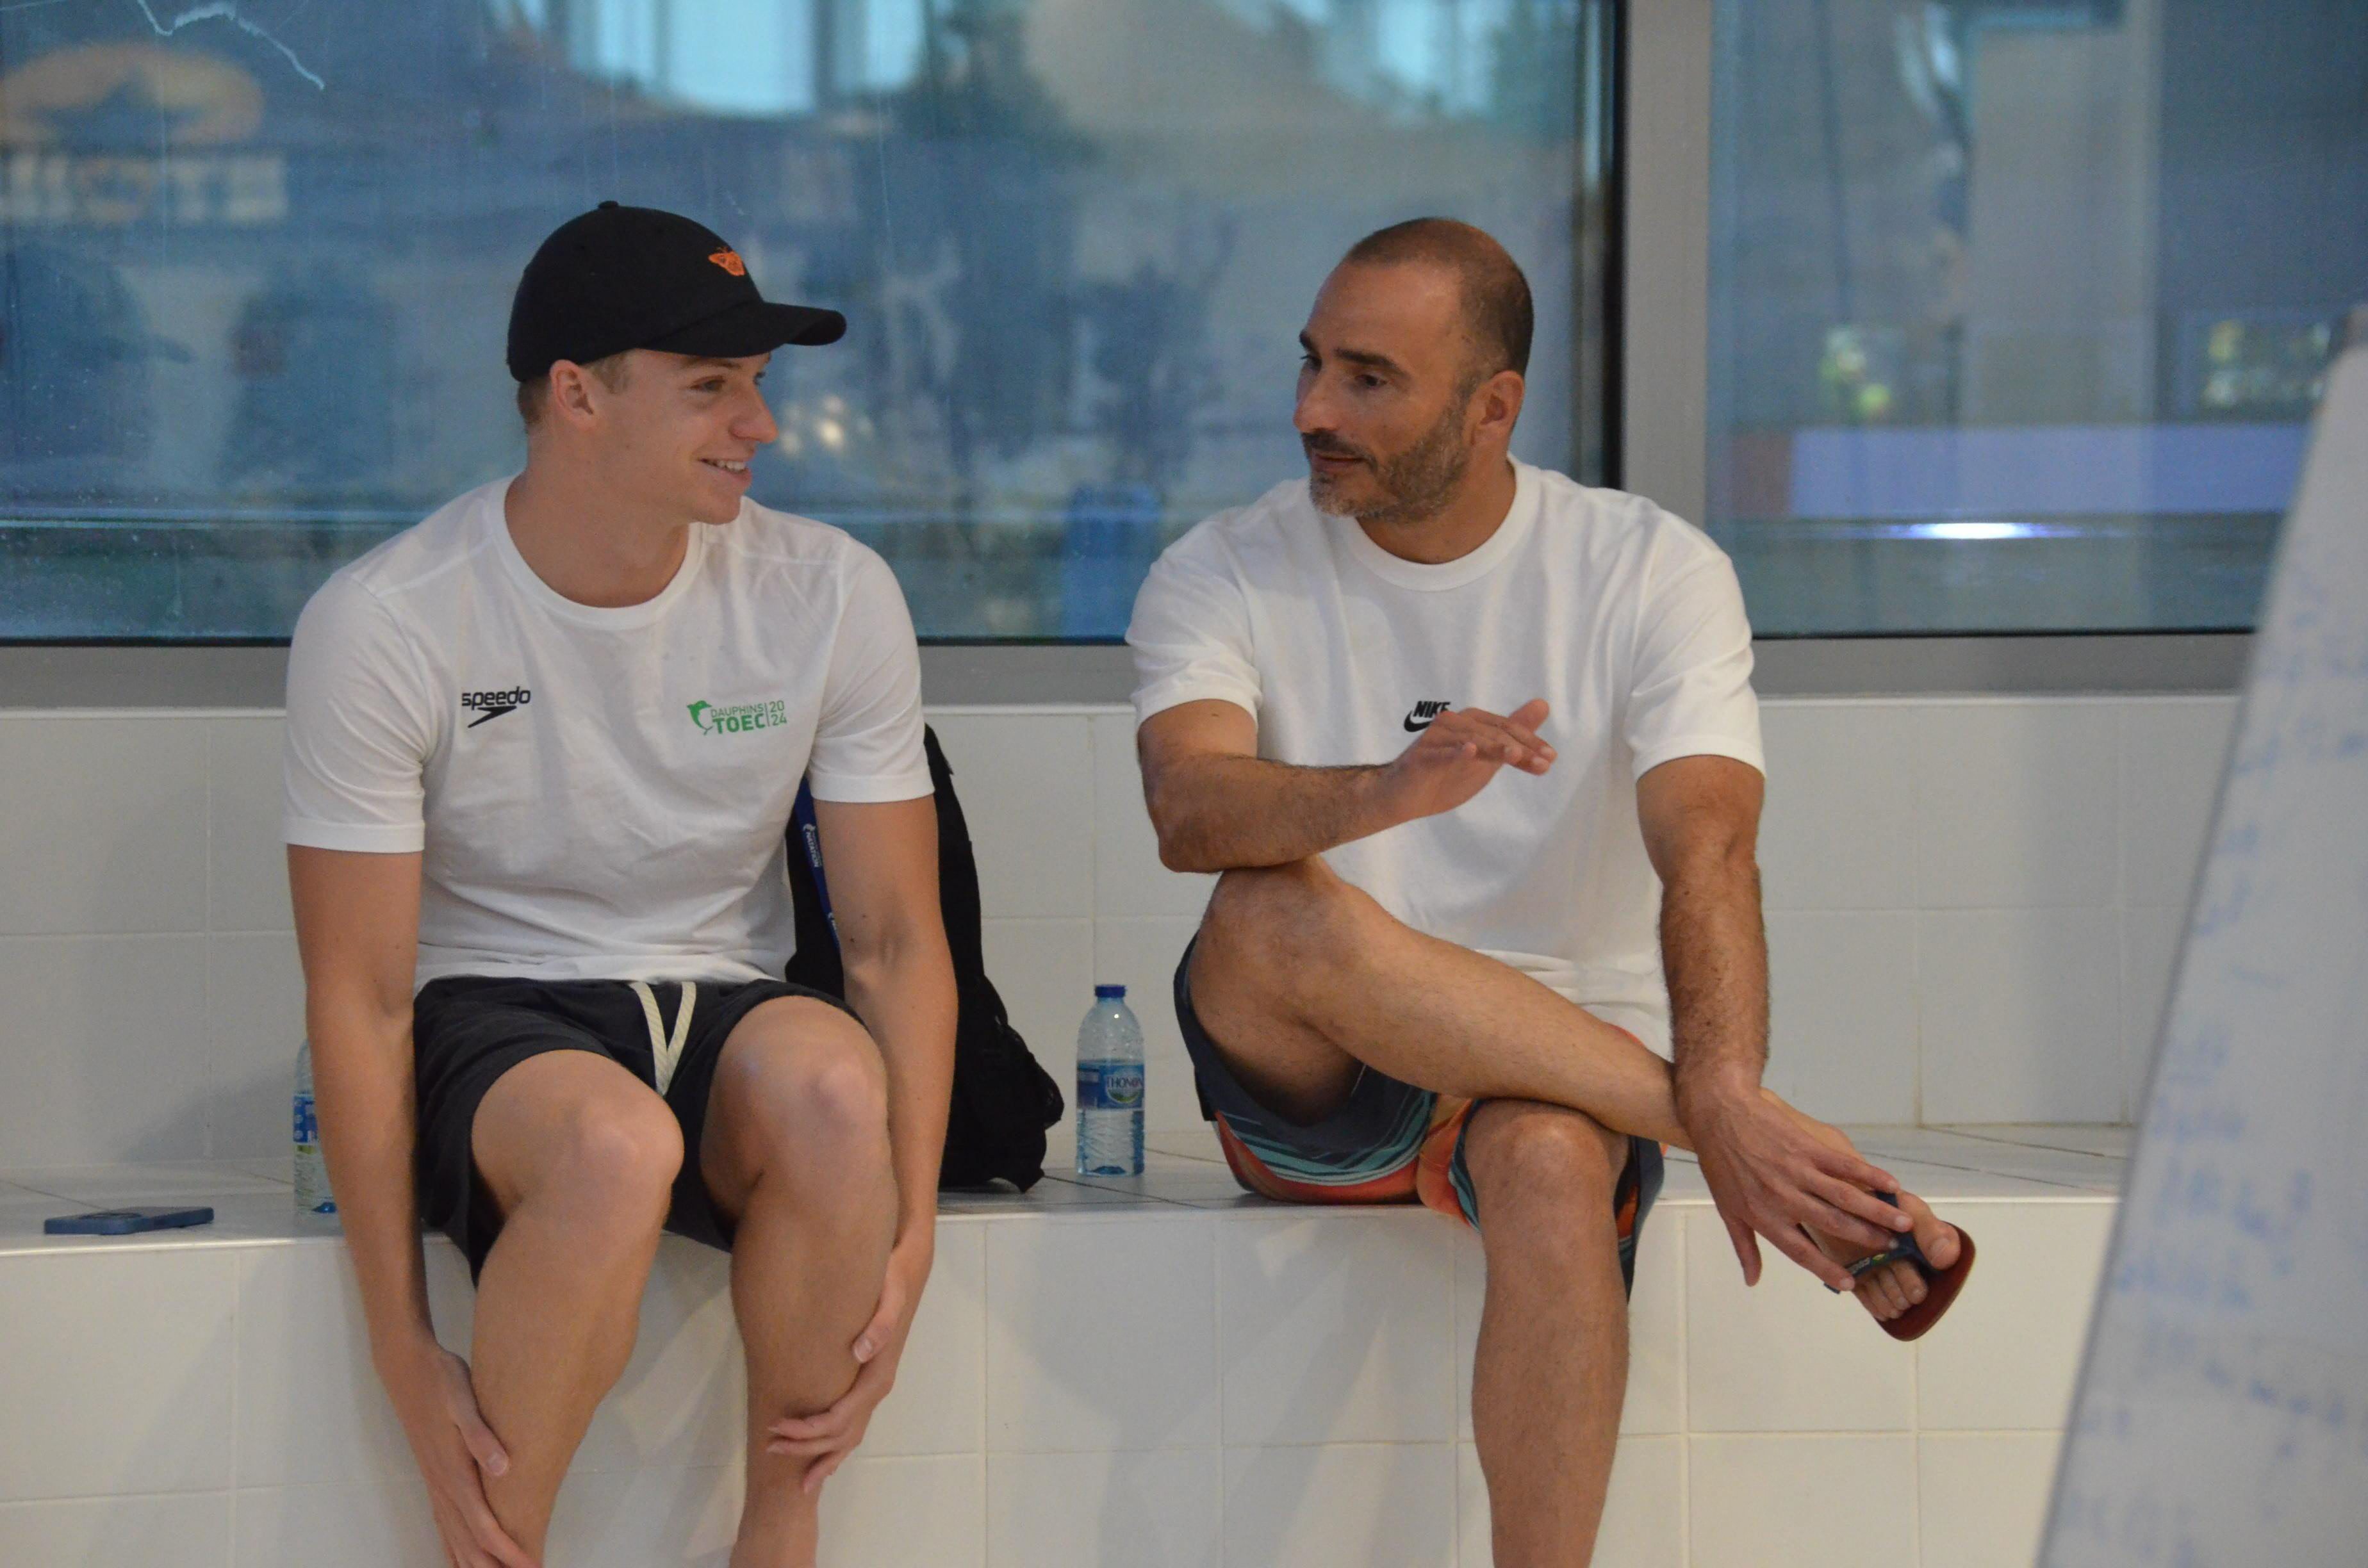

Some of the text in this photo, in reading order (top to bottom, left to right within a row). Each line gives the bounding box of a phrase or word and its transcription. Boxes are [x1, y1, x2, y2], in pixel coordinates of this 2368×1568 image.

[461, 686, 530, 710] speedo
[711, 703, 764, 718] DAUPHINS
[769, 700, 785, 713] 20
[712, 713, 766, 734] TOEC
[771, 713, 787, 726] 24
